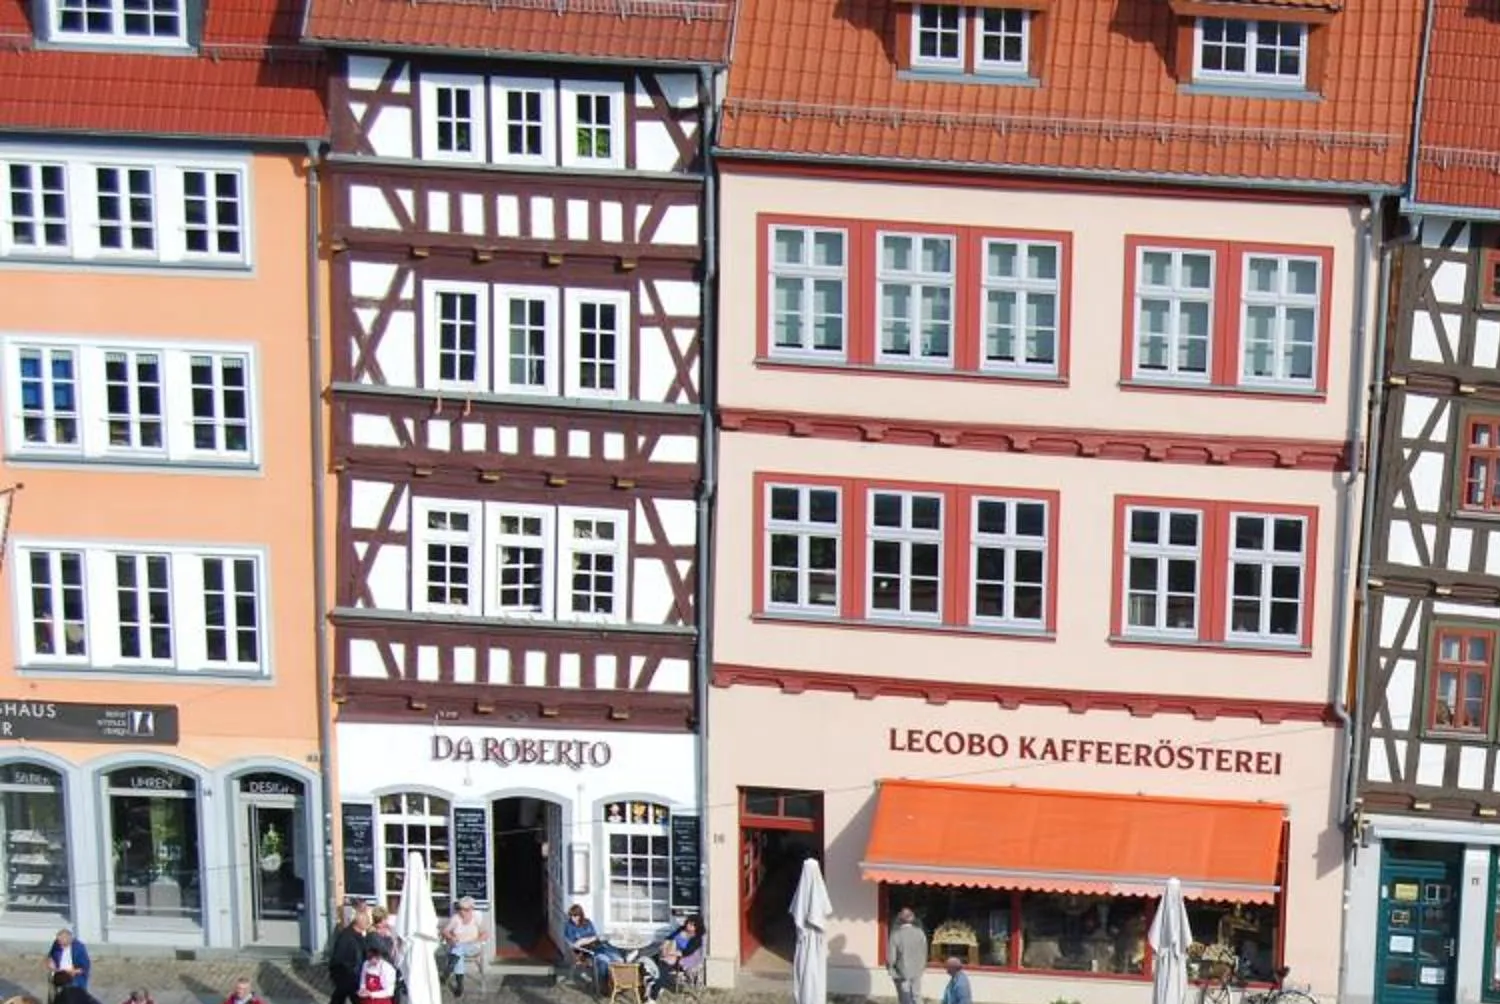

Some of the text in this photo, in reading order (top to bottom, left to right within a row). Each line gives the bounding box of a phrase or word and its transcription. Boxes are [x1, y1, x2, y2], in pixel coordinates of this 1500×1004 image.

[431, 734, 612, 770] DA ROBERTO
[889, 727, 1283, 776] LECOBO KAFFEERÖSTEREI
